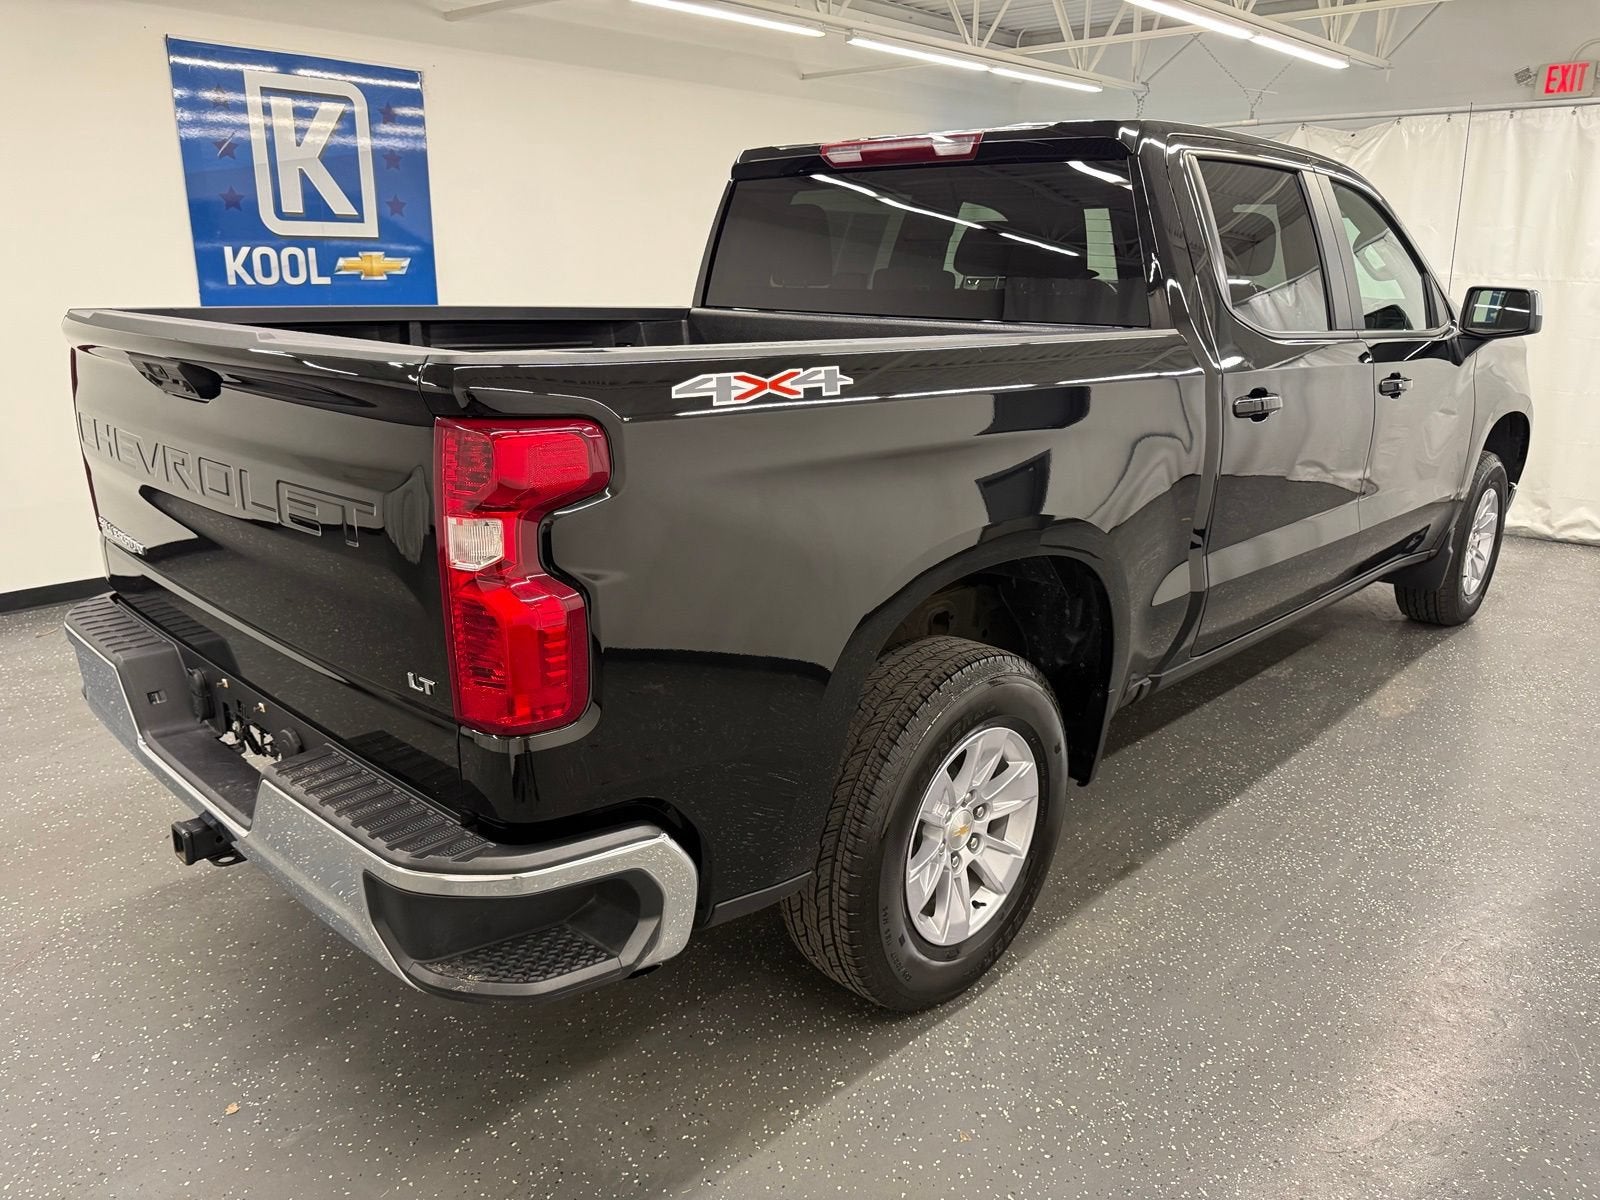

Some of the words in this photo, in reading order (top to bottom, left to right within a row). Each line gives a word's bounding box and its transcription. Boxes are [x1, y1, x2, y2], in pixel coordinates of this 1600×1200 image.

[1544, 62, 1590, 94] EXIT
[270, 96, 359, 216] K
[223, 245, 332, 286] KOOL
[78, 409, 378, 548] CHEVROLET
[407, 671, 436, 696] LT
